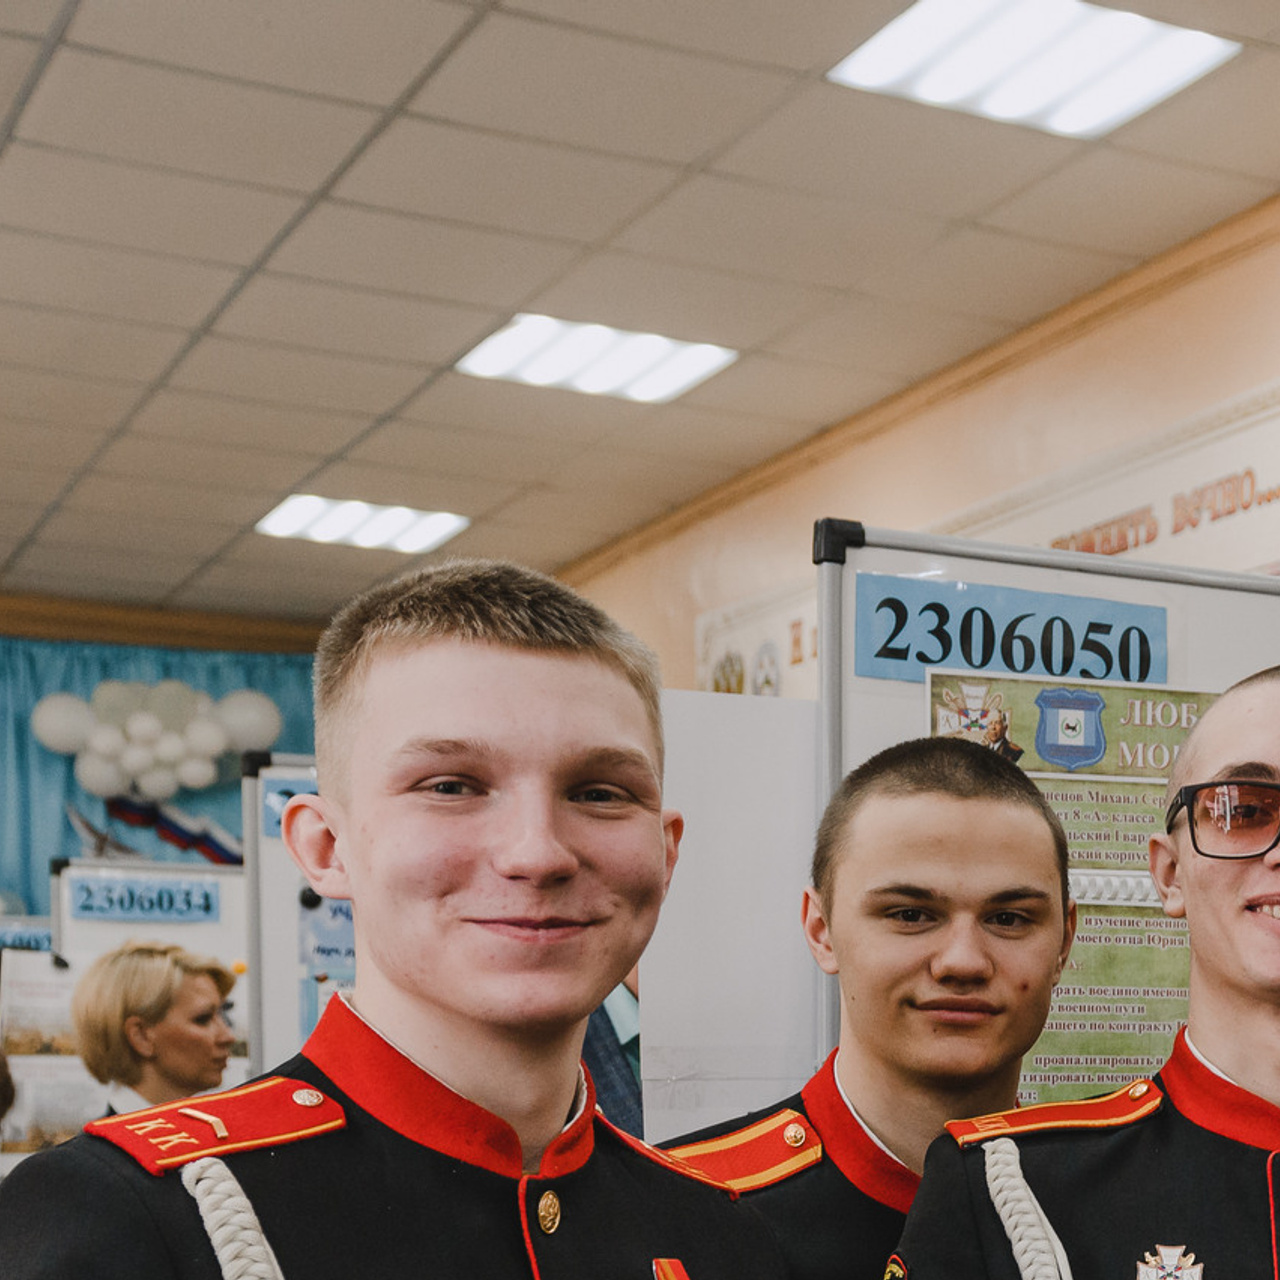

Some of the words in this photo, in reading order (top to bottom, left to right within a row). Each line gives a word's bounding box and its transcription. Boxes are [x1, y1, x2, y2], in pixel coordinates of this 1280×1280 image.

[873, 597, 1152, 682] 2306050
[1118, 741, 1179, 769] МО
[1044, 791, 1083, 801] нецов
[1089, 790, 1137, 804] Михаил
[1057, 811, 1068, 820] ет
[1073, 809, 1080, 820] 8
[1112, 815, 1155, 823] класса
[1068, 830, 1110, 841] льский
[1115, 830, 1149, 845] Гвар
[1071, 849, 1102, 860] ский
[1105, 853, 1149, 864] корпус
[78, 878, 213, 914] 2306034
[1084, 916, 1142, 930] изучение
[1145, 919, 1189, 929] военно
[1076, 934, 1111, 943] моего
[1115, 935, 1143, 945] отца
[1147, 935, 1184, 948] Юрия
[1068, 960, 1084, 971] А:
[1089, 987, 1139, 998] воедино
[1143, 988, 1189, 999] имеющ
[1058, 1004, 1110, 1013] военном
[1115, 1006, 1145, 1016] пути
[1043, 1021, 1086, 1032] ащего
[1090, 1022, 1104, 1031] по
[1108, 1023, 1173, 1034] контракту
[1035, 1055, 1152, 1068] проанализировать
[1155, 1056, 1163, 1066] и
[1022, 1073, 1094, 1085] тизировать
[1017, 1090, 1038, 1101] ал;
